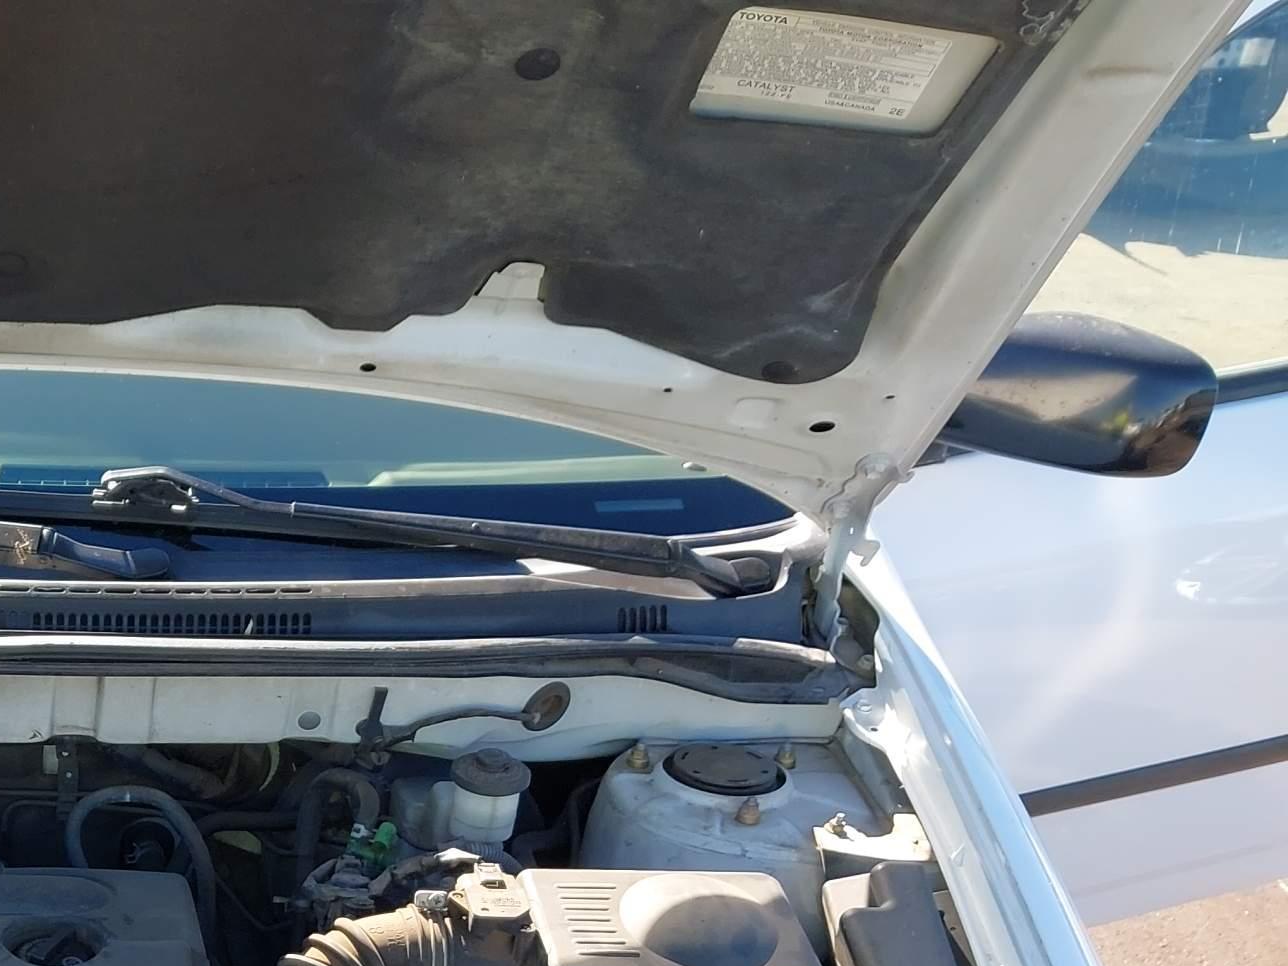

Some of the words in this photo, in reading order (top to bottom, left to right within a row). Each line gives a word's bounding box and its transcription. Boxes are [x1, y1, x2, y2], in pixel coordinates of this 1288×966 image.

[738, 12, 788, 25] TOYOTA
[737, 79, 796, 93] CATALYST
[888, 107, 906, 117] 2E
